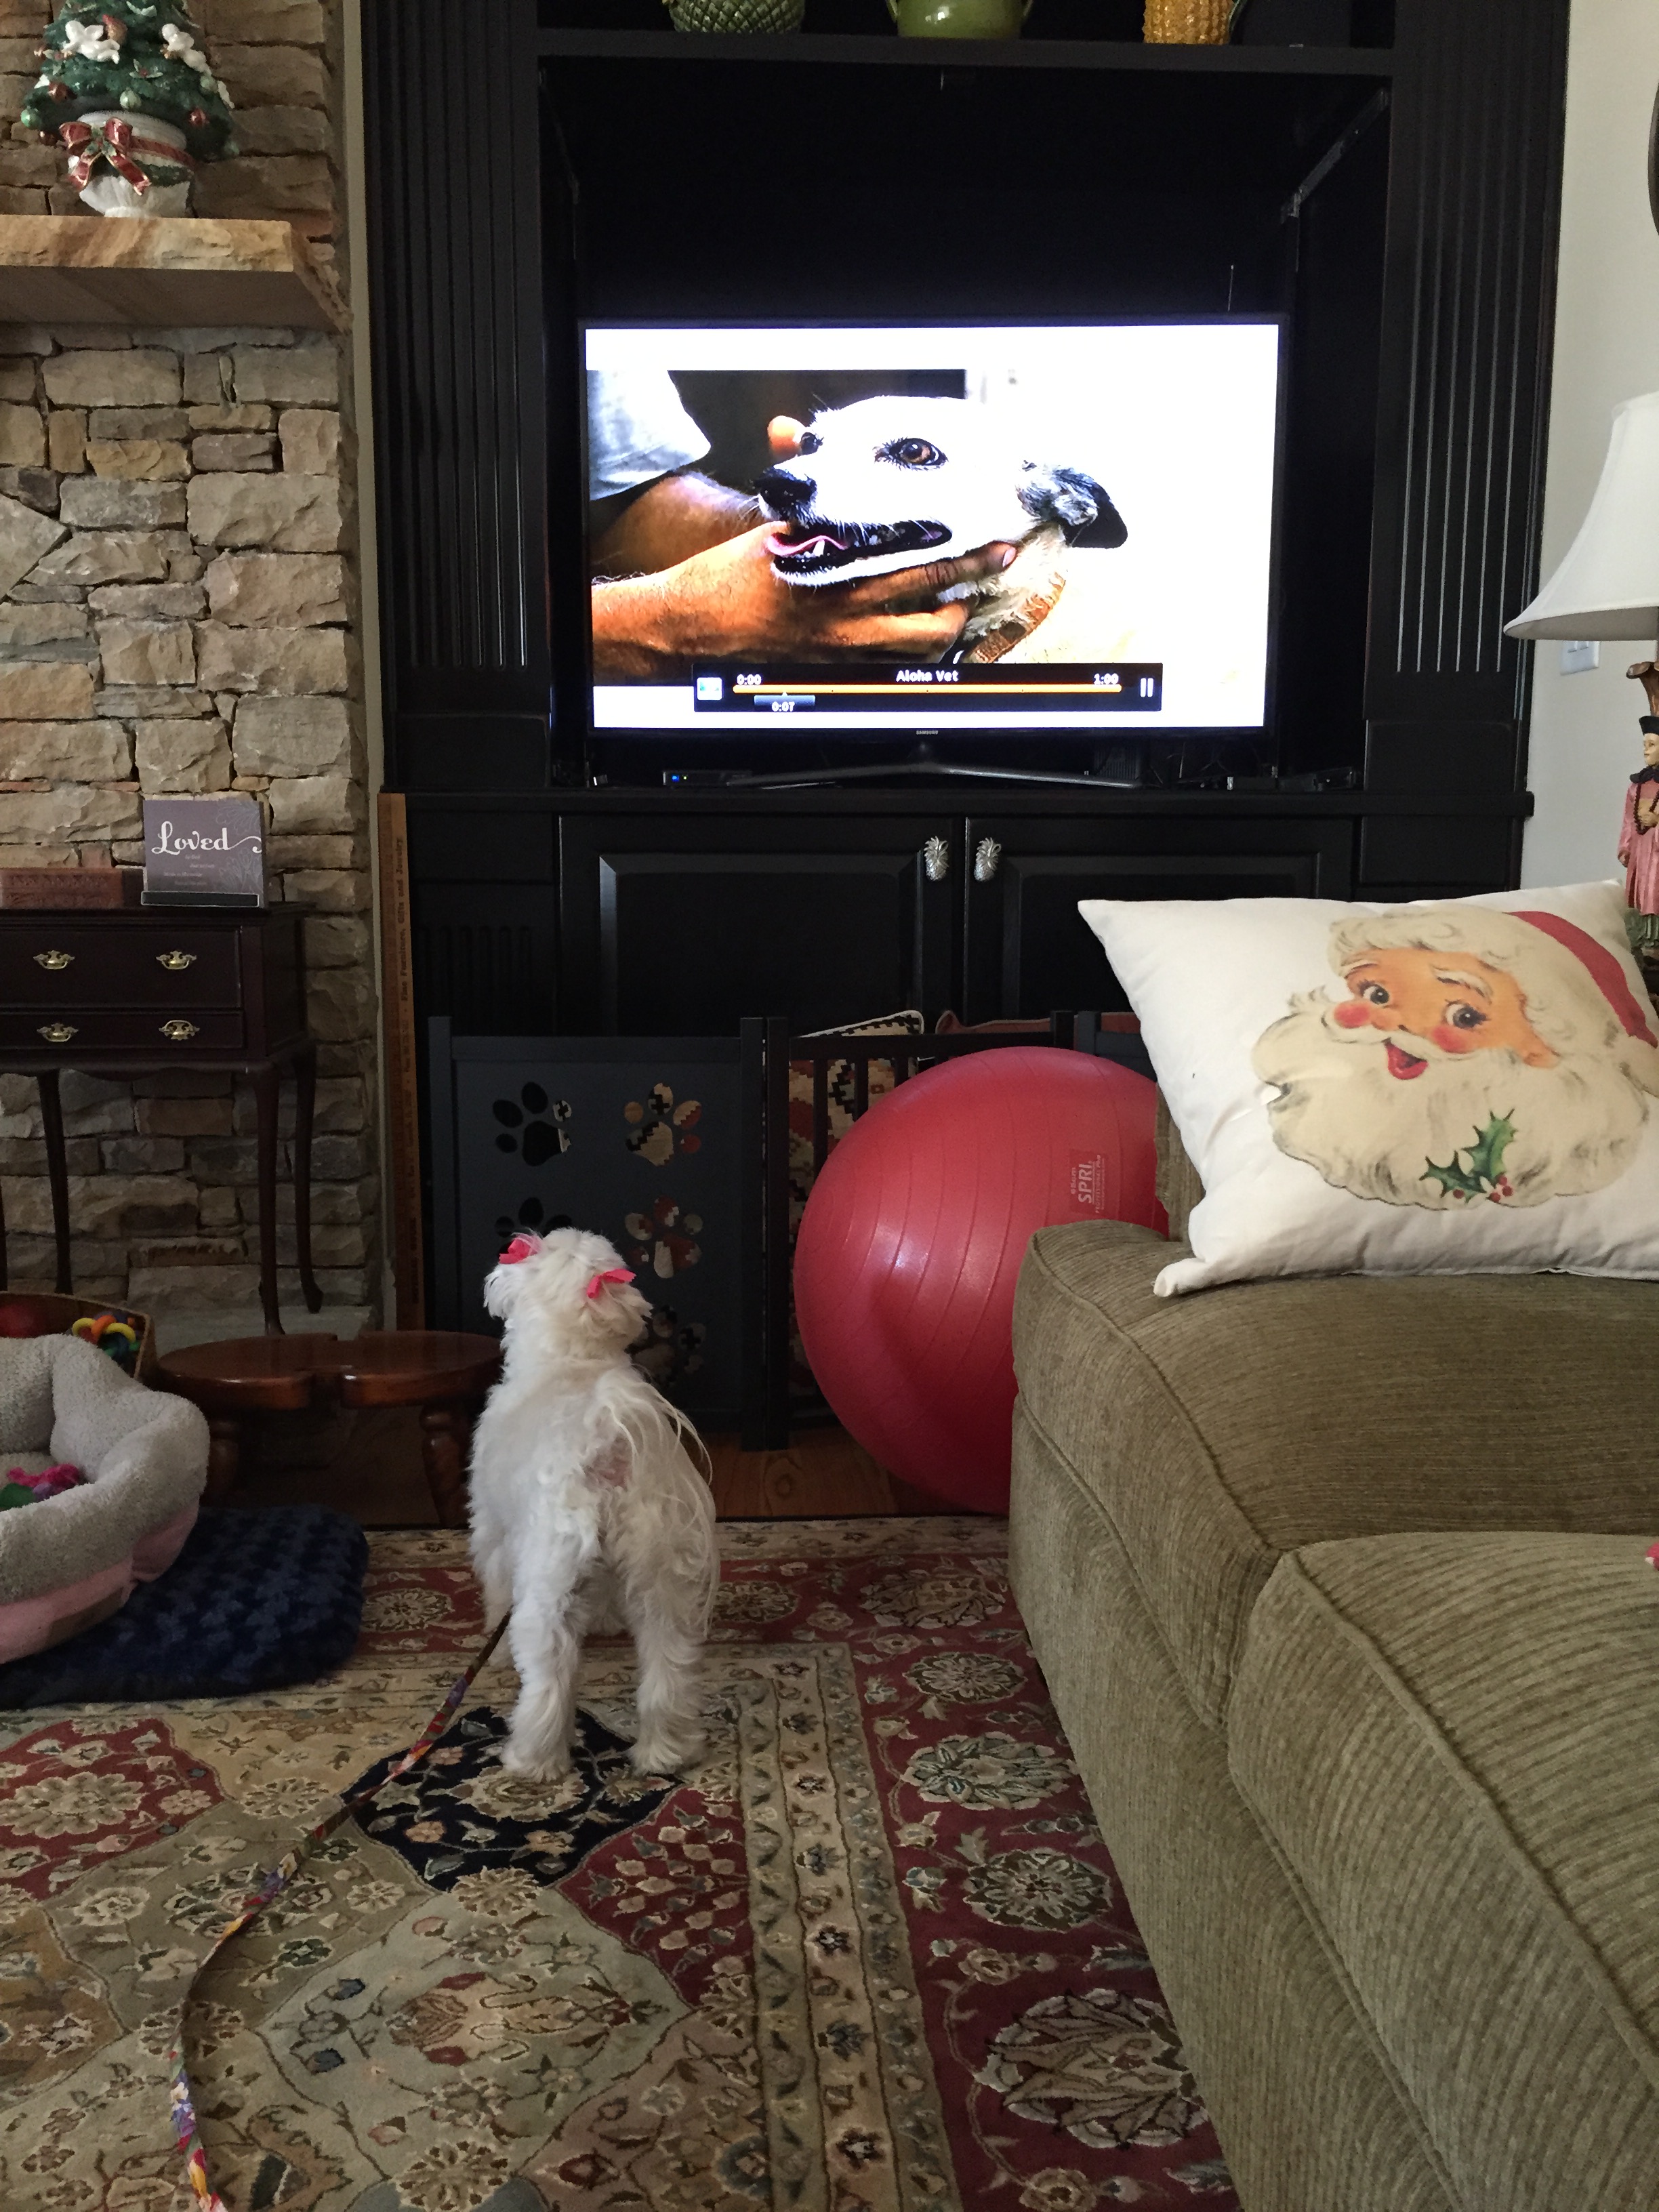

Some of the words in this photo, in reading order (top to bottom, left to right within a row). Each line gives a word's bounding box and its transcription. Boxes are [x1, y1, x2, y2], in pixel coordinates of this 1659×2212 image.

[737, 674, 762, 685] 0:00
[896, 670, 933, 682] Aloha
[935, 670, 958, 682] Vet
[1094, 673, 1119, 684] 1:00
[771, 701, 795, 712] 0:07
[150, 821, 262, 855] Loved
[1078, 1164, 1092, 1204] SPRI
